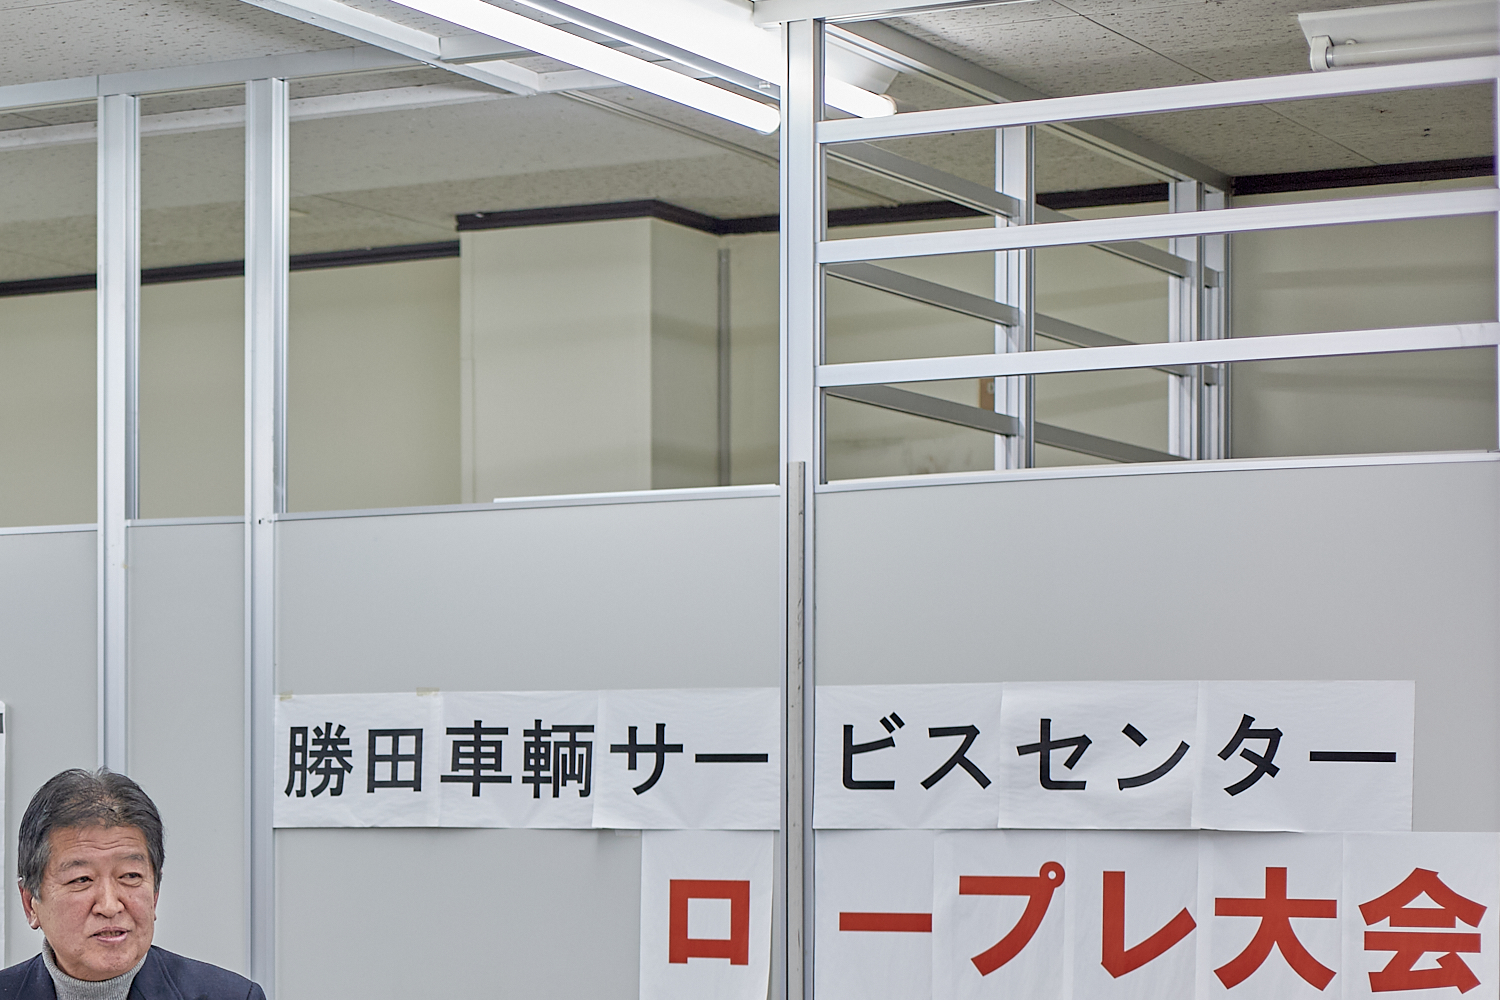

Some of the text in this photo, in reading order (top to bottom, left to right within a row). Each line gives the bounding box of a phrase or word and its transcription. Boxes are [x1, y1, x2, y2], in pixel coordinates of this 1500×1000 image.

[667, 860, 1488, 995] ロープレ大会
